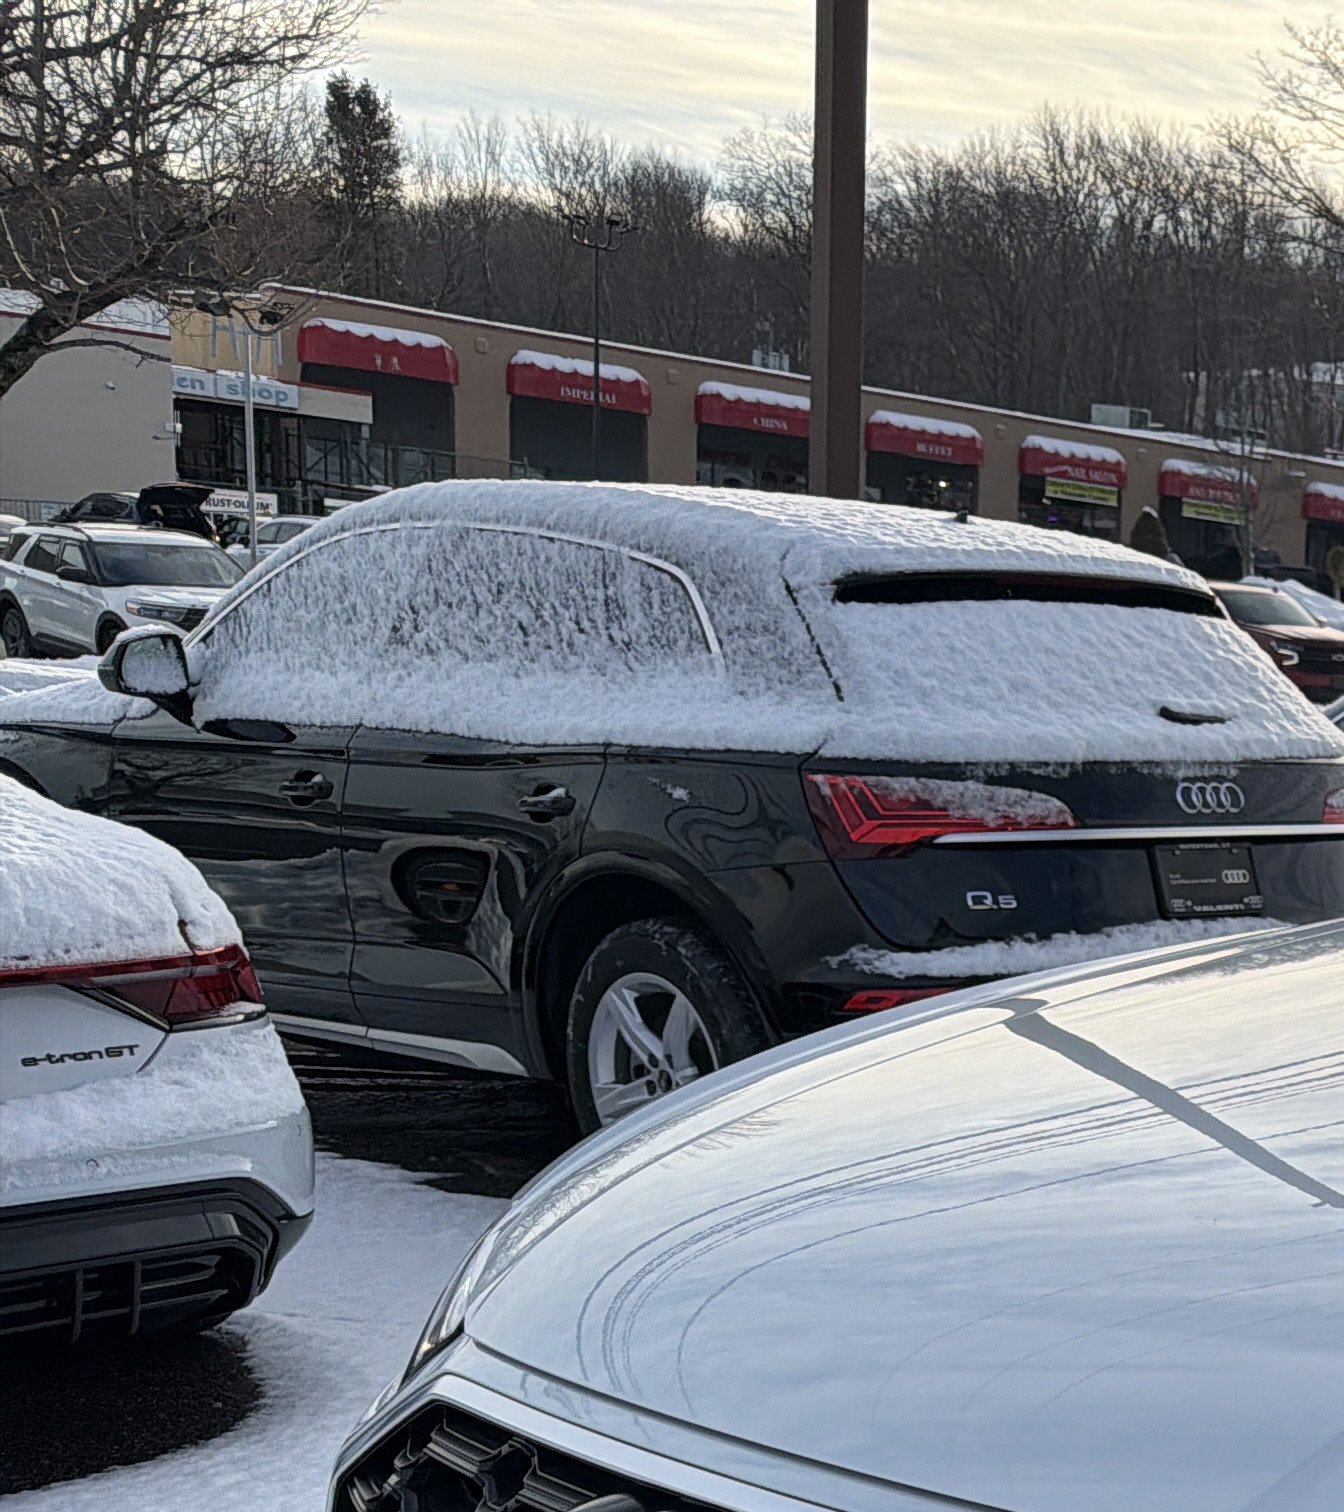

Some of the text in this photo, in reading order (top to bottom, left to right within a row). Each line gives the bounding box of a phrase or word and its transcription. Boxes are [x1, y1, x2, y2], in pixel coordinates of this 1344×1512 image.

[966, 891, 1018, 910] Q5
[20, 1043, 140, 1067] e-tron GT
